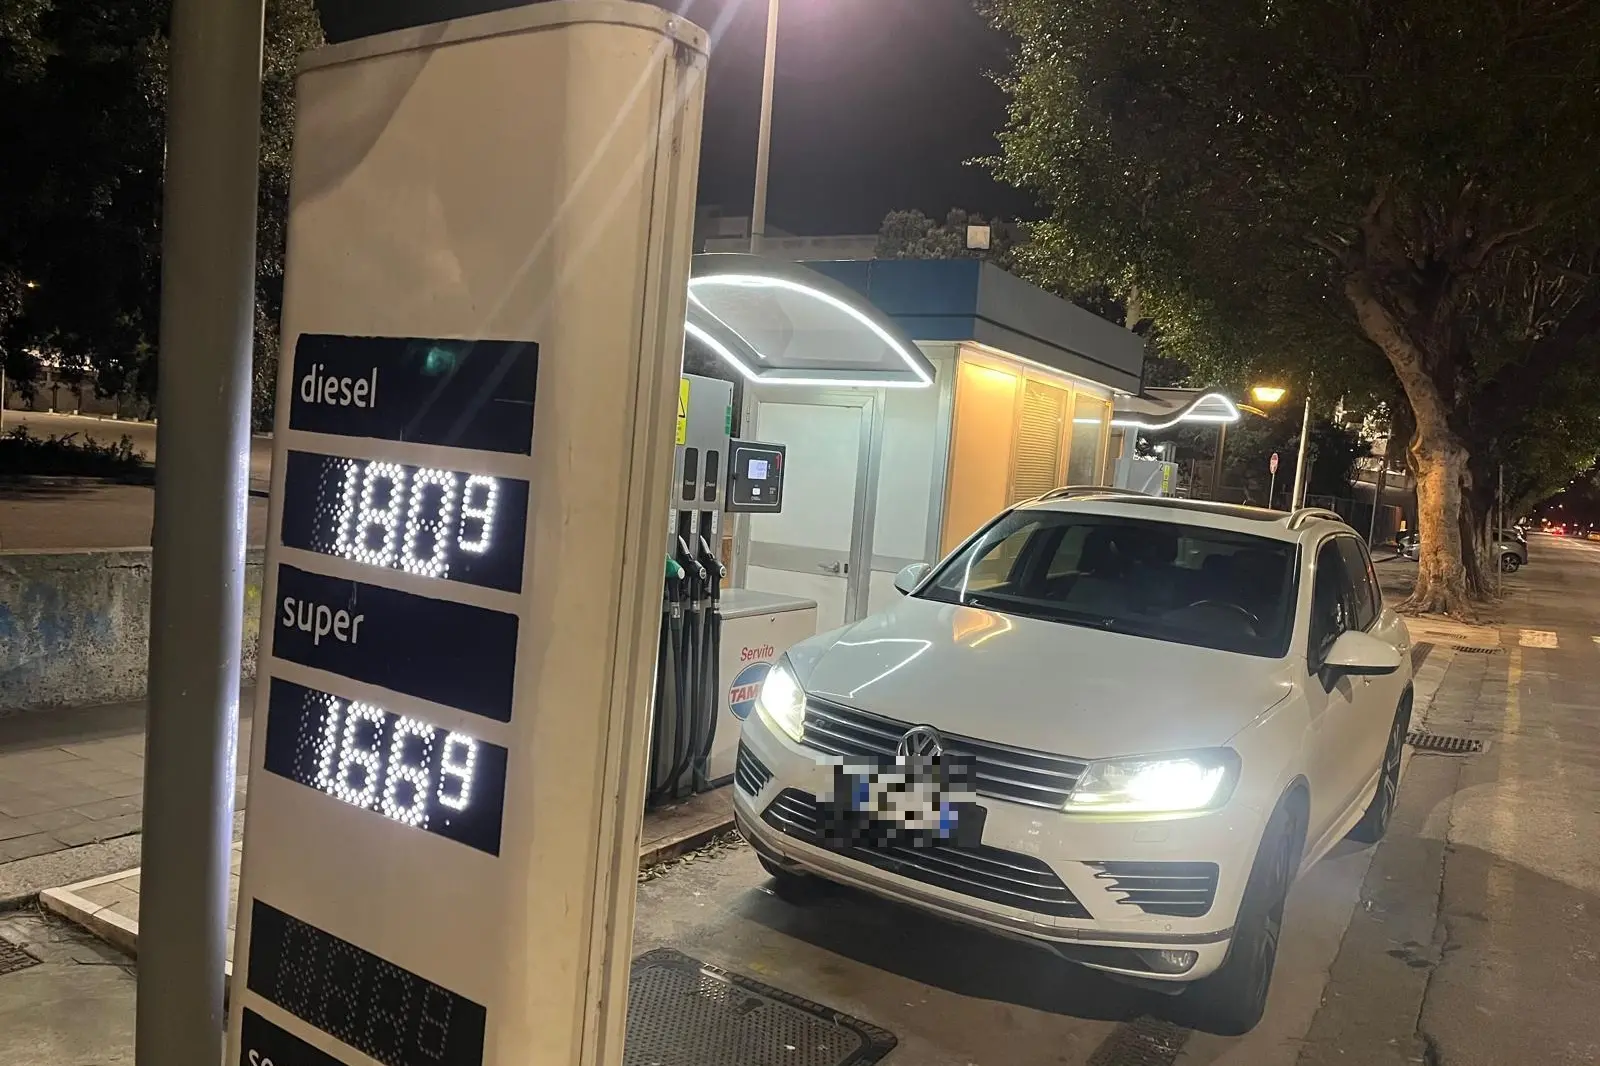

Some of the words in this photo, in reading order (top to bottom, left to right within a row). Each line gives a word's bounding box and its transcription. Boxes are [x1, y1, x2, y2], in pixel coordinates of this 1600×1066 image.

[301, 363, 378, 408] diesel
[283, 596, 364, 645] super
[740, 644, 774, 661] Servito
